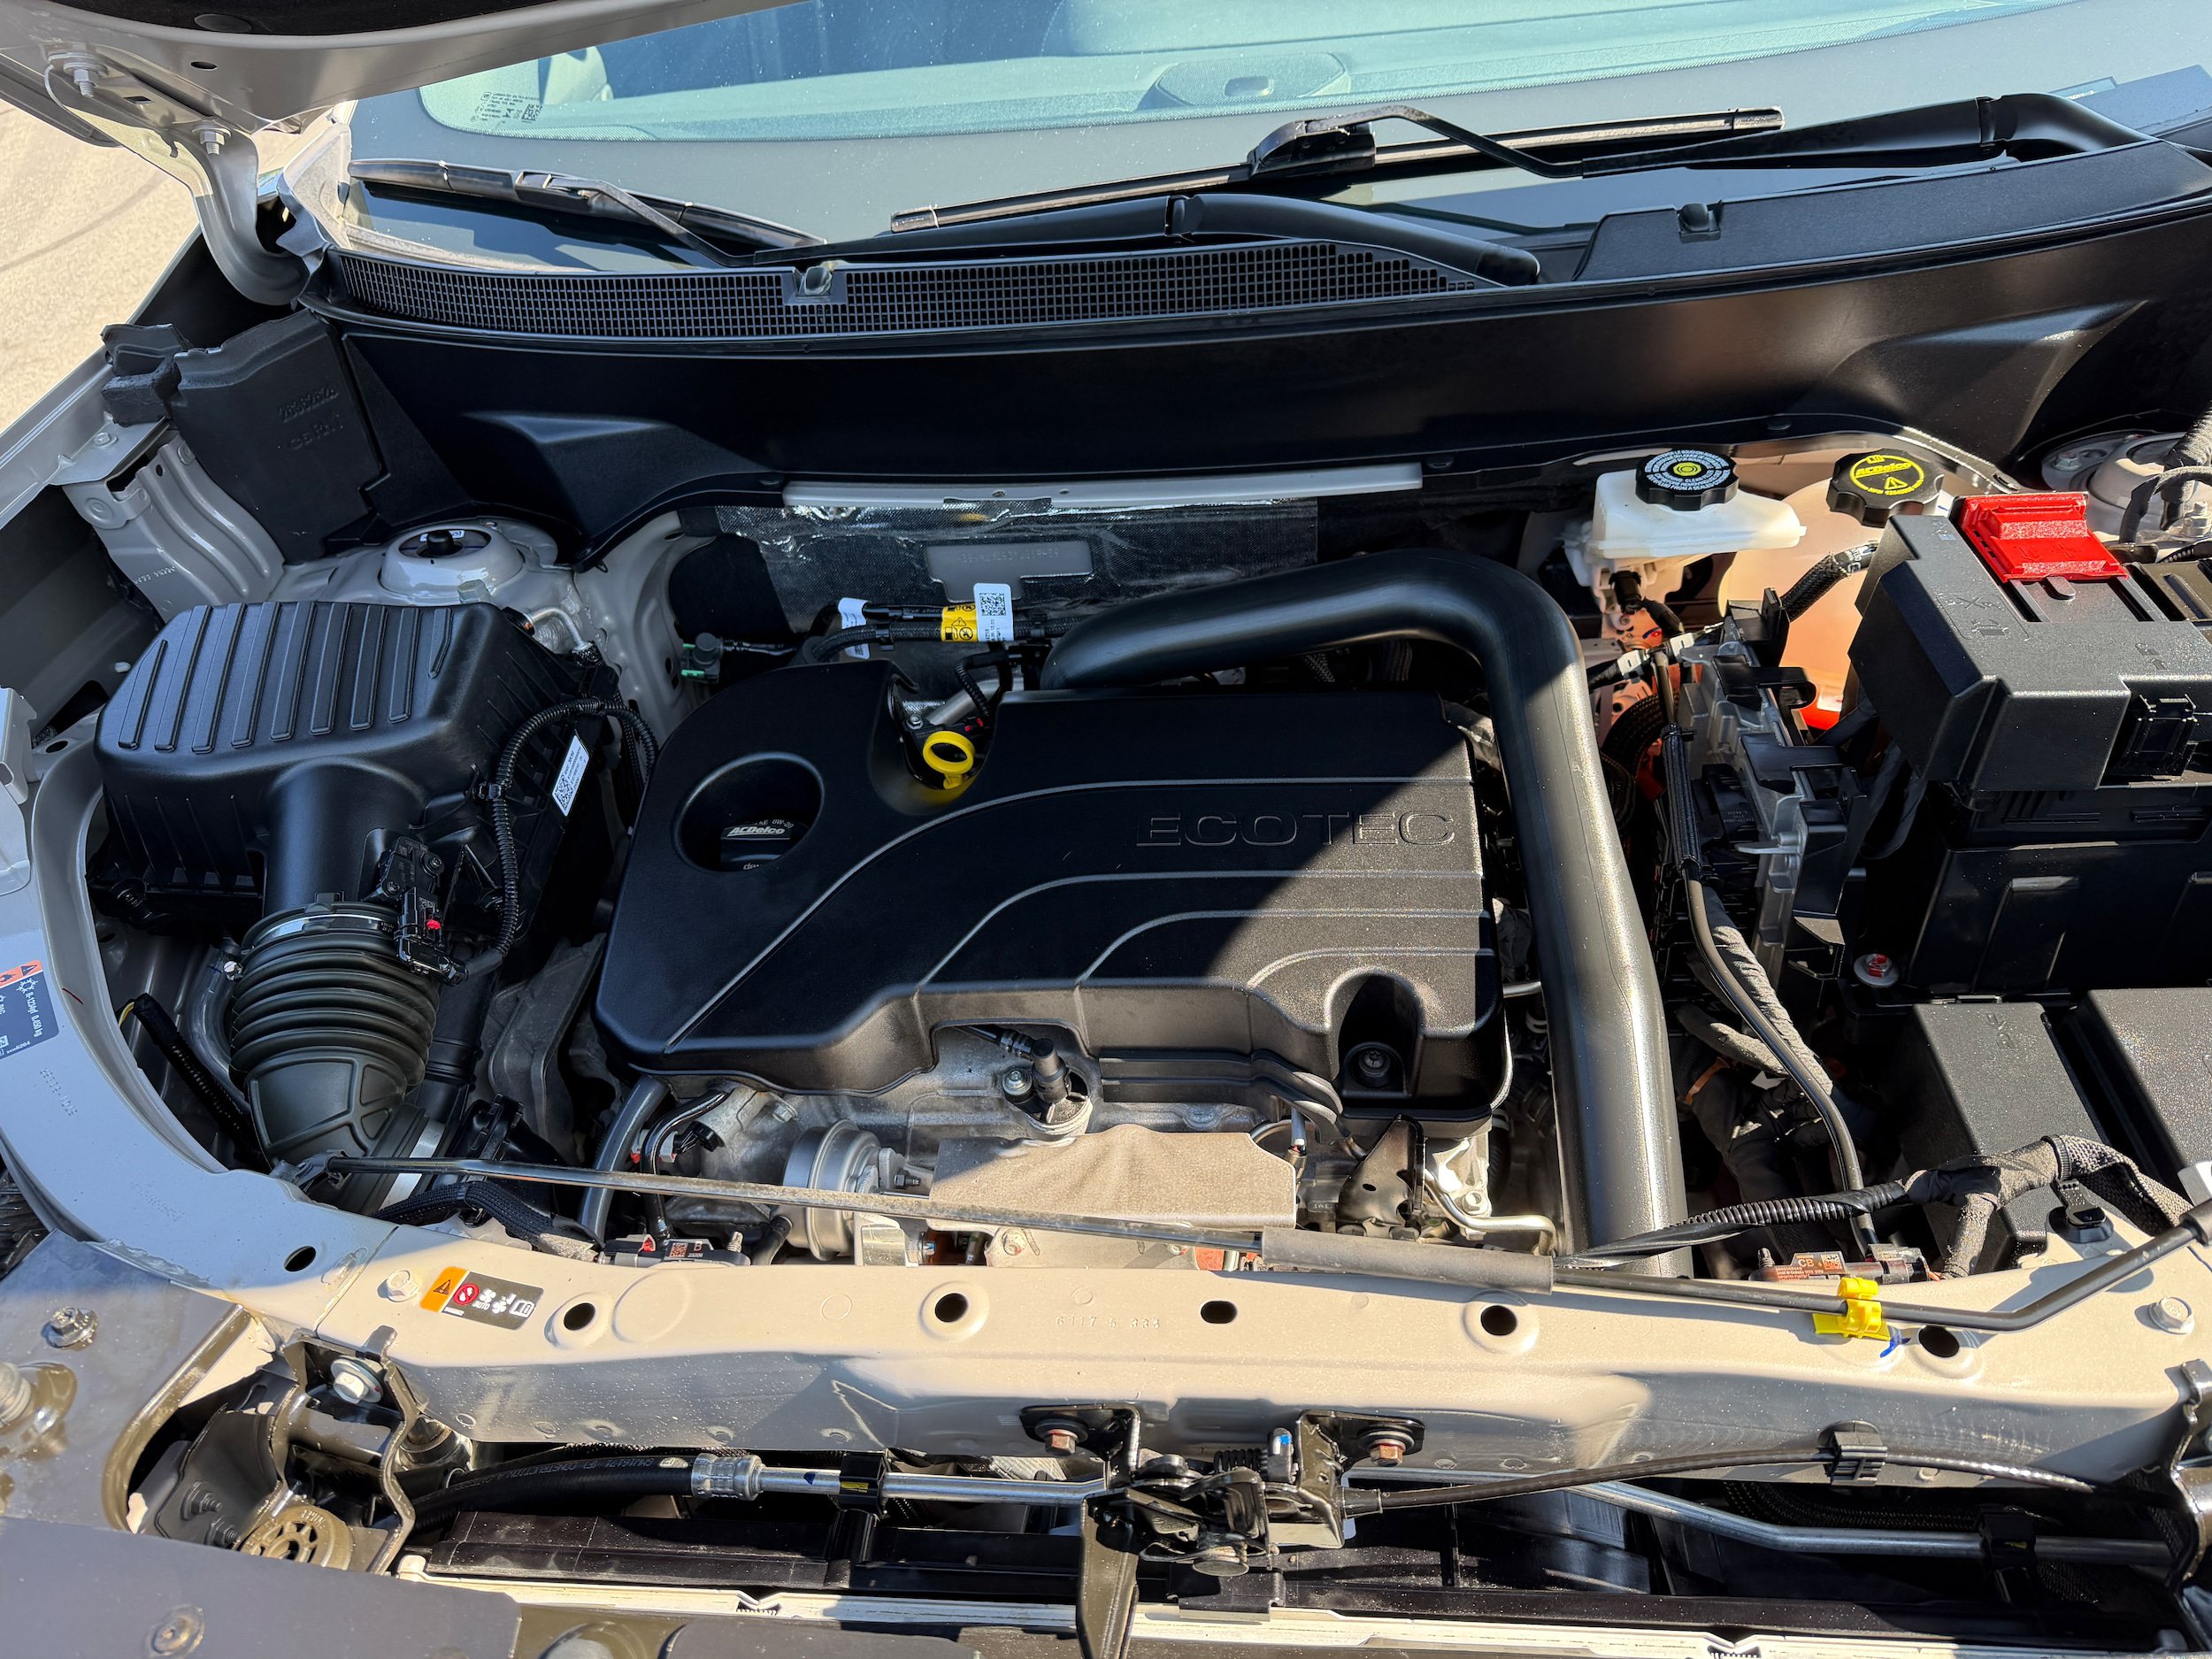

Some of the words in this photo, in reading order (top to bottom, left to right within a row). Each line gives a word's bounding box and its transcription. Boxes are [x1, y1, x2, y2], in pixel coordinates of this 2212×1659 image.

[772, 818, 794, 829] 0W-20
[1137, 811, 1455, 847] ECOTEC
[726, 826, 785, 837] ACDelco
[694, 1240, 703, 1251] B
[1797, 1258, 1815, 1268] CB
[471, 1300, 491, 1311] AUTO
